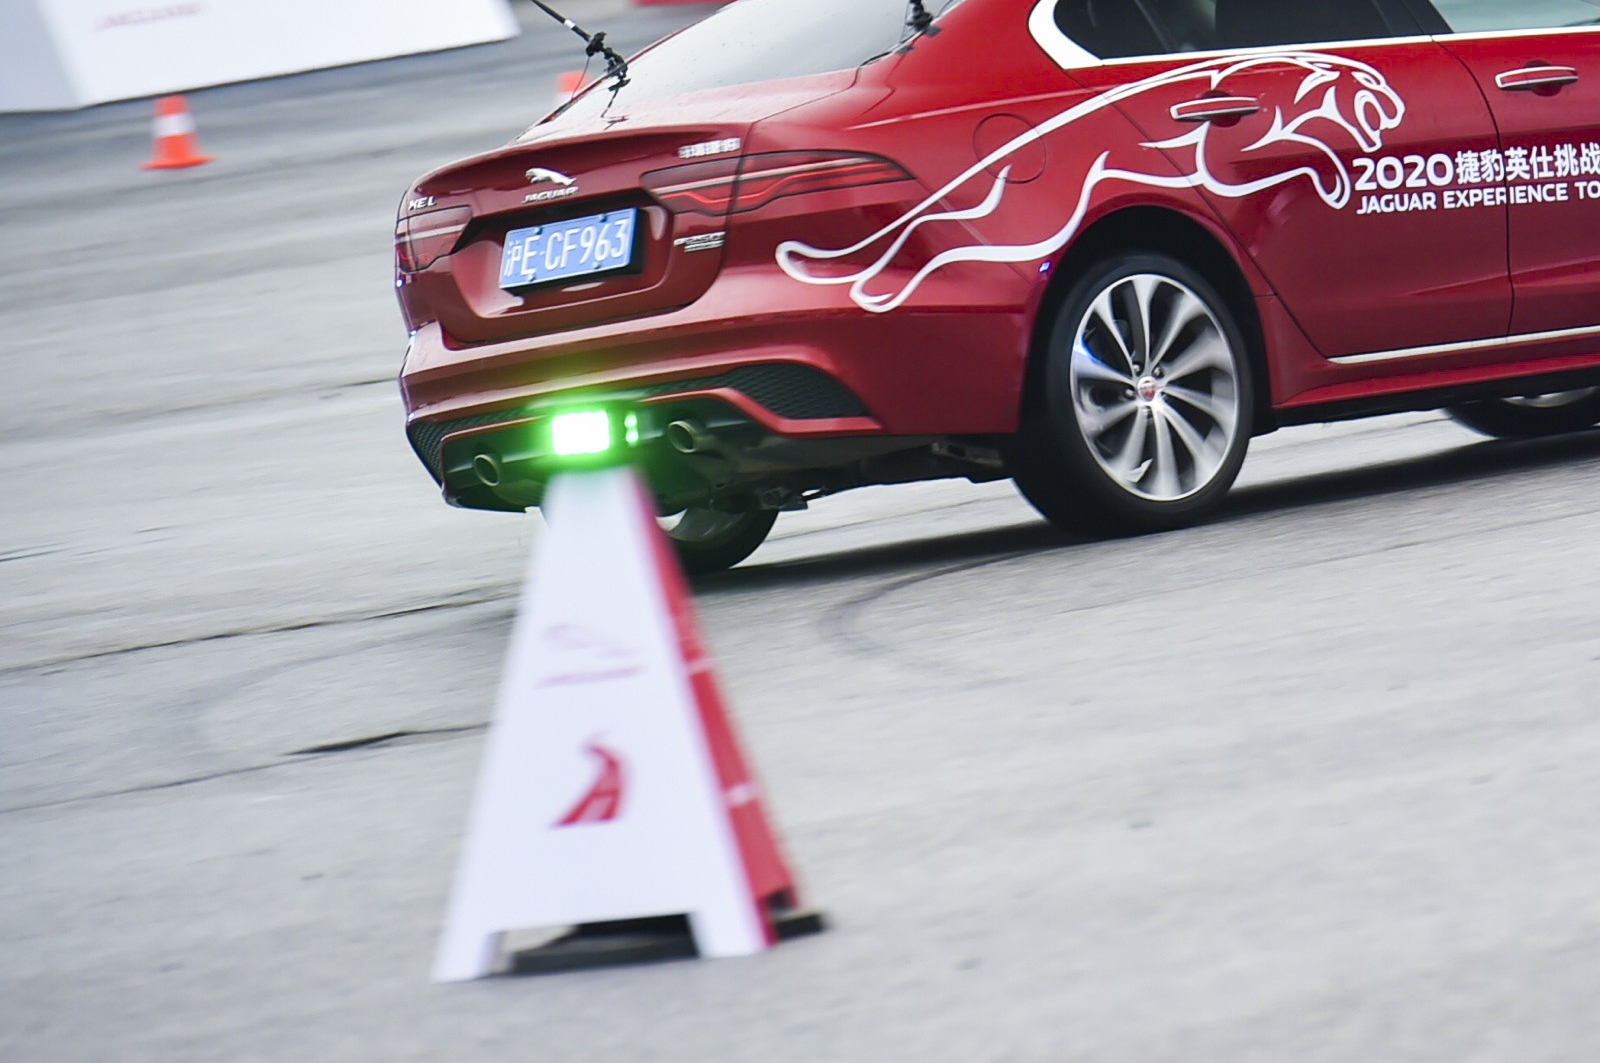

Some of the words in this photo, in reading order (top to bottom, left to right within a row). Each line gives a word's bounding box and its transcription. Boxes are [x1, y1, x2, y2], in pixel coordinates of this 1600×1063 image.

[408, 196, 437, 211] XEL
[521, 186, 579, 204] JAGUAR
[1356, 191, 1437, 215] JAGUAR
[1443, 183, 1569, 209] EXPERIENCE
